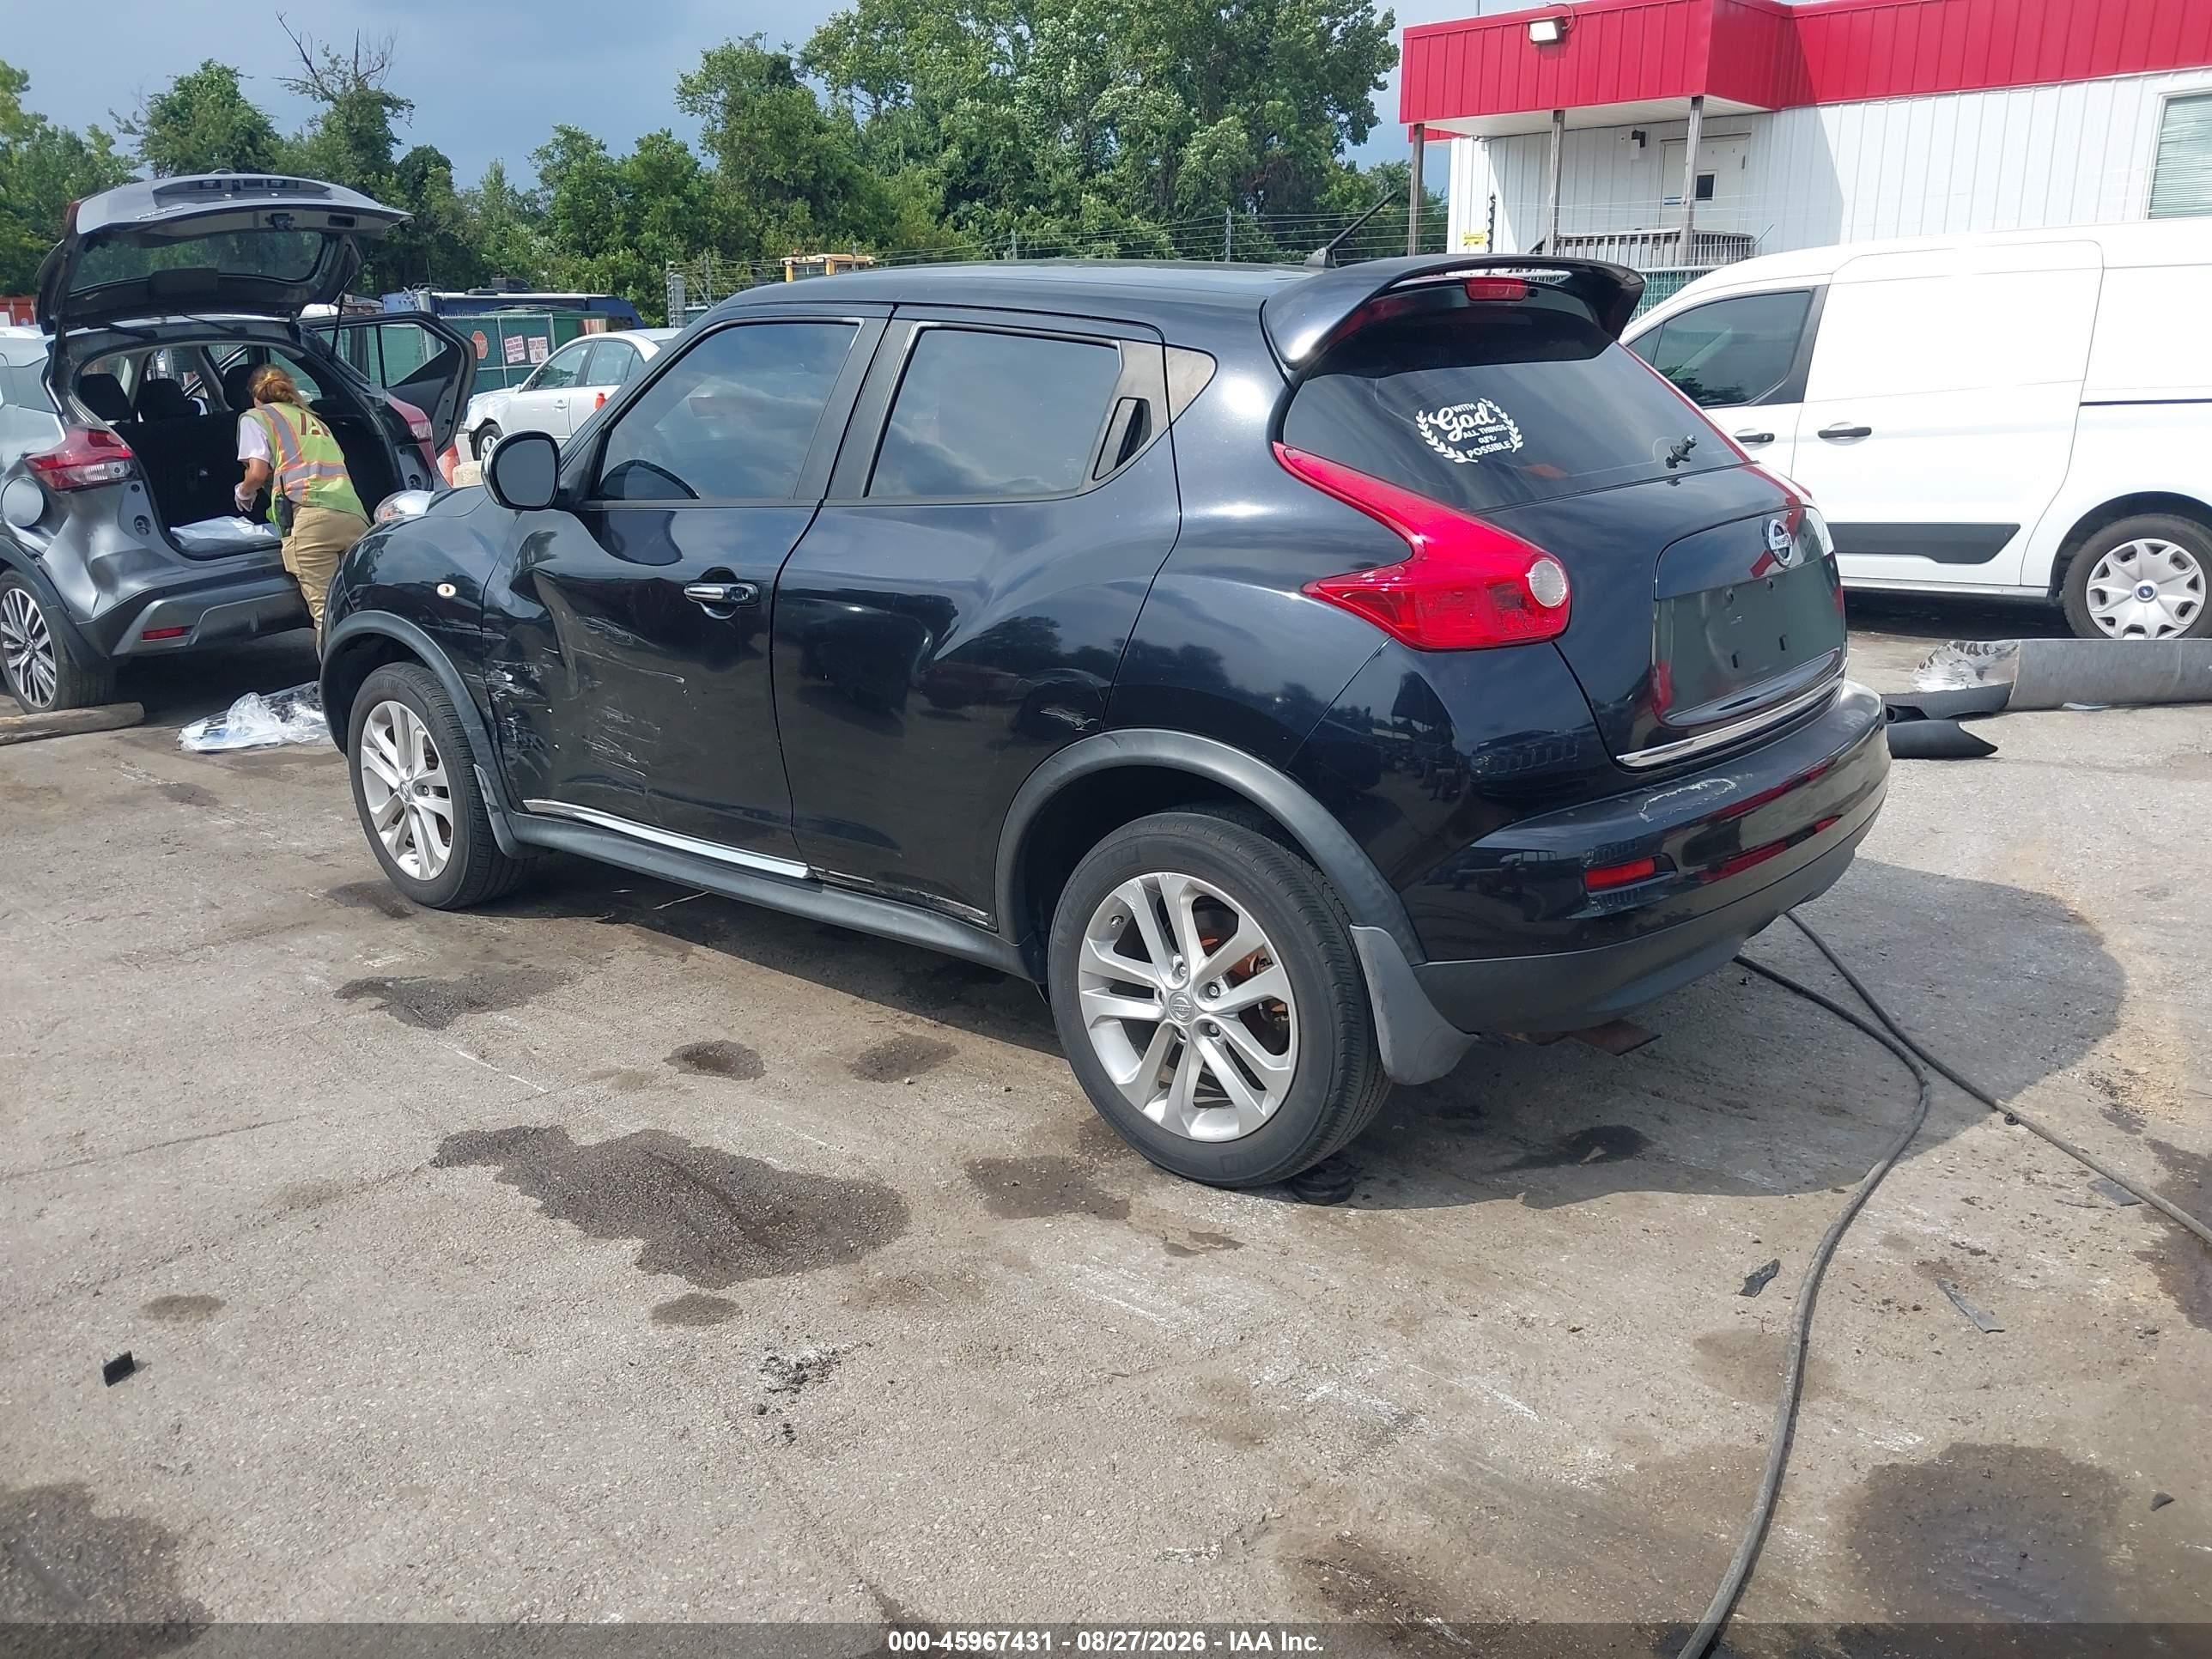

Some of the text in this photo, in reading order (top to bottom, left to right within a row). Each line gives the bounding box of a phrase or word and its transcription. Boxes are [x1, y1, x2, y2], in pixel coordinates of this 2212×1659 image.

[1450, 403, 1477, 413] WITH
[1427, 403, 1497, 442] God
[1462, 424, 1508, 439] ALL THINGS
[1478, 435, 1498, 445] are
[1466, 440, 1513, 459] POSSIBLE
